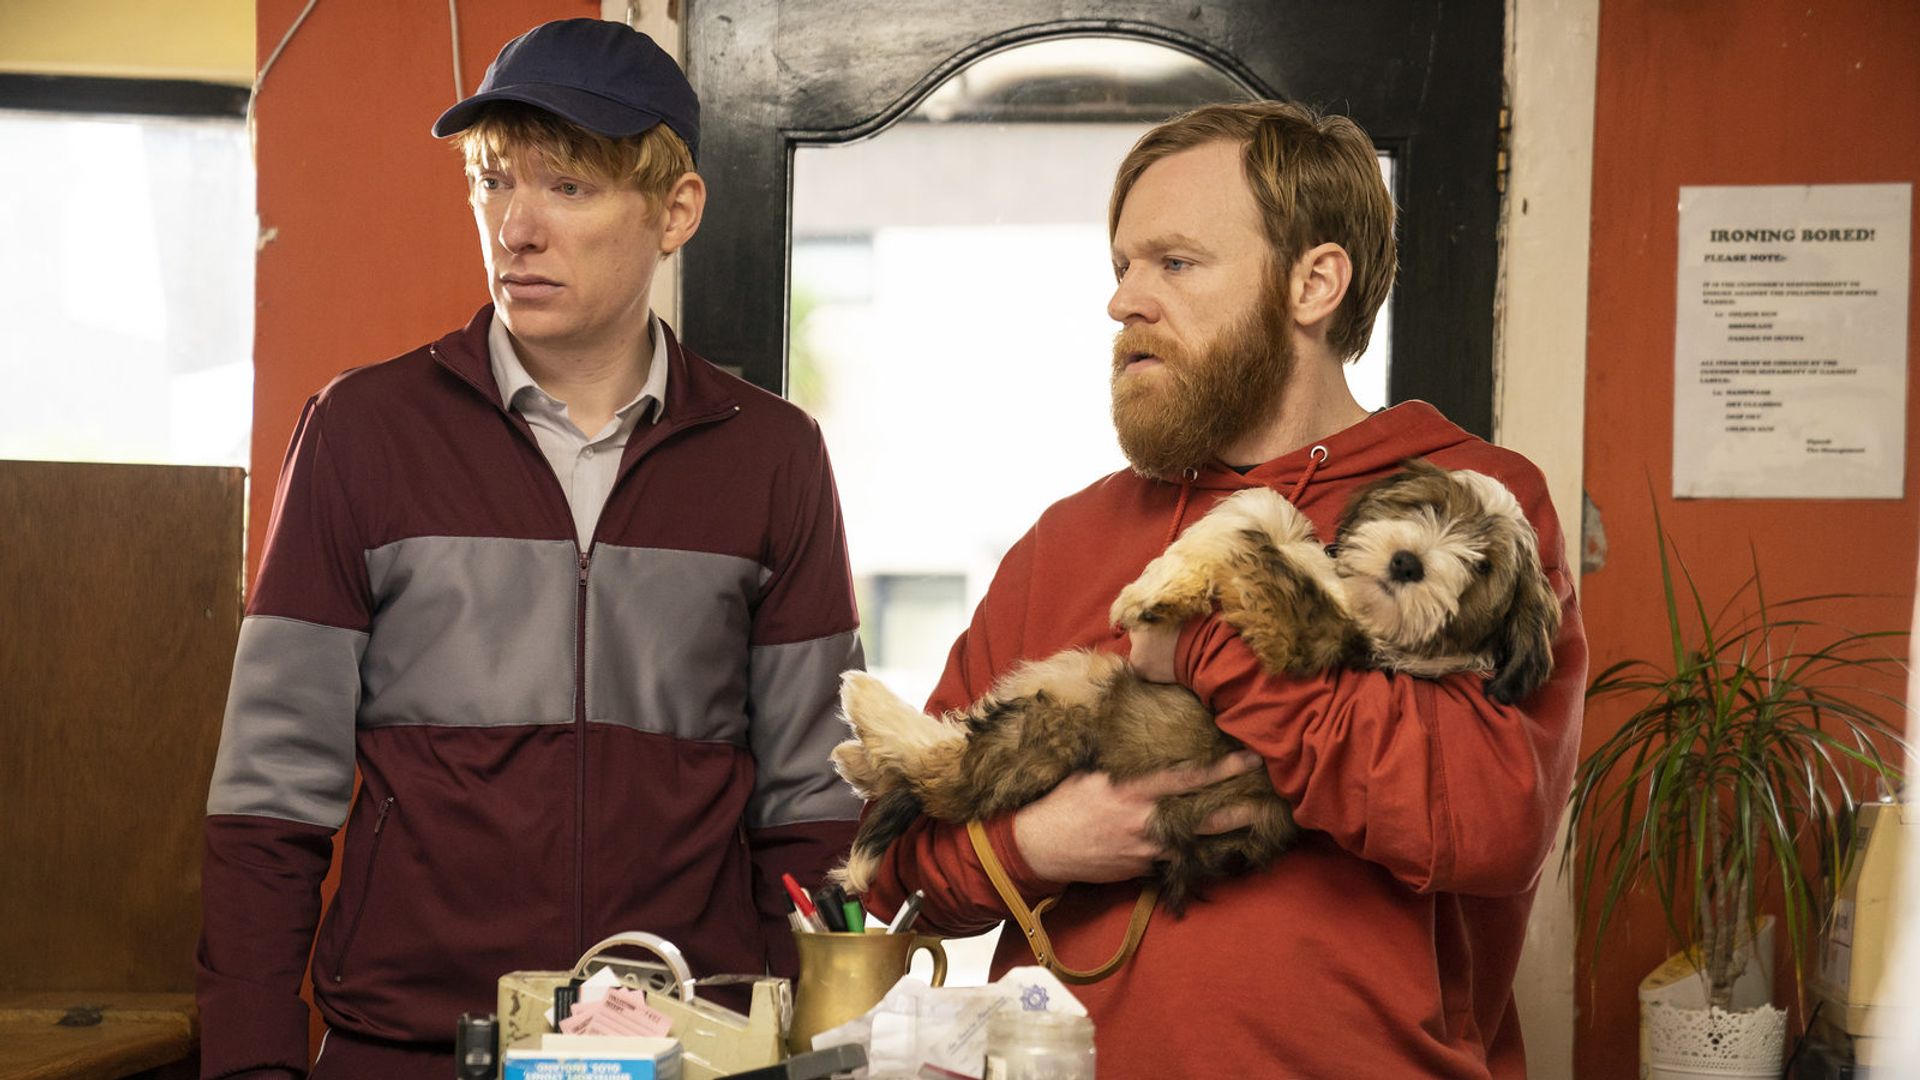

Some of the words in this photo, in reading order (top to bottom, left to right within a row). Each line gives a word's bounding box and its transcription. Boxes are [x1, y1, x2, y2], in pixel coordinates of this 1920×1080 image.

[1710, 228, 1795, 242] IRONING
[1802, 228, 1876, 242] BORED!
[1704, 253, 1747, 262] PLEASE
